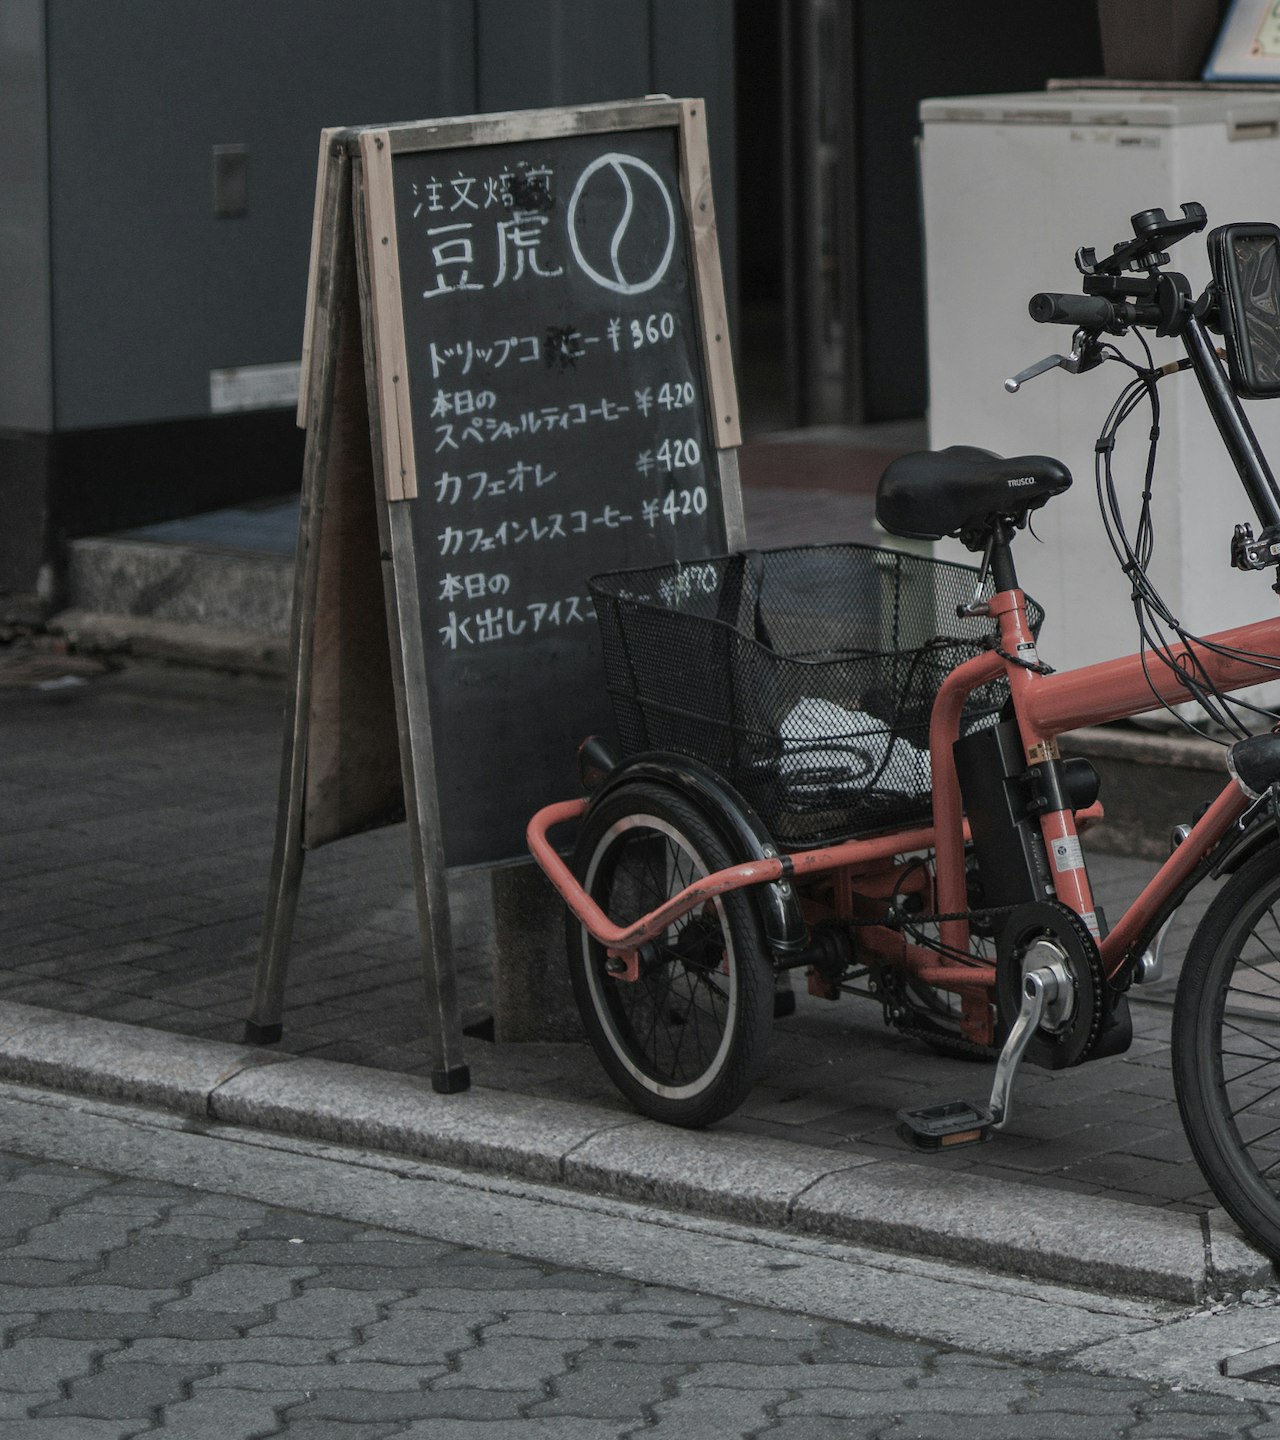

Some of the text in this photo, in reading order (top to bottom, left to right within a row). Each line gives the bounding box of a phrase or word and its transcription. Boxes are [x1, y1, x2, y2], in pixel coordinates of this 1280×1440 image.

[422, 209, 564, 298] 豆虎
[606, 312, 675, 354] ¥360
[430, 388, 498, 419] 本日の
[434, 380, 696, 454] スペシャルティコーヒー ¥420
[434, 436, 701, 506] カフェオレ ¥420
[1007, 476, 1035, 488] TRUSCO
[437, 484, 710, 557] カフェインレスコーヒー ¥420
[438, 572, 512, 603] 本日の
